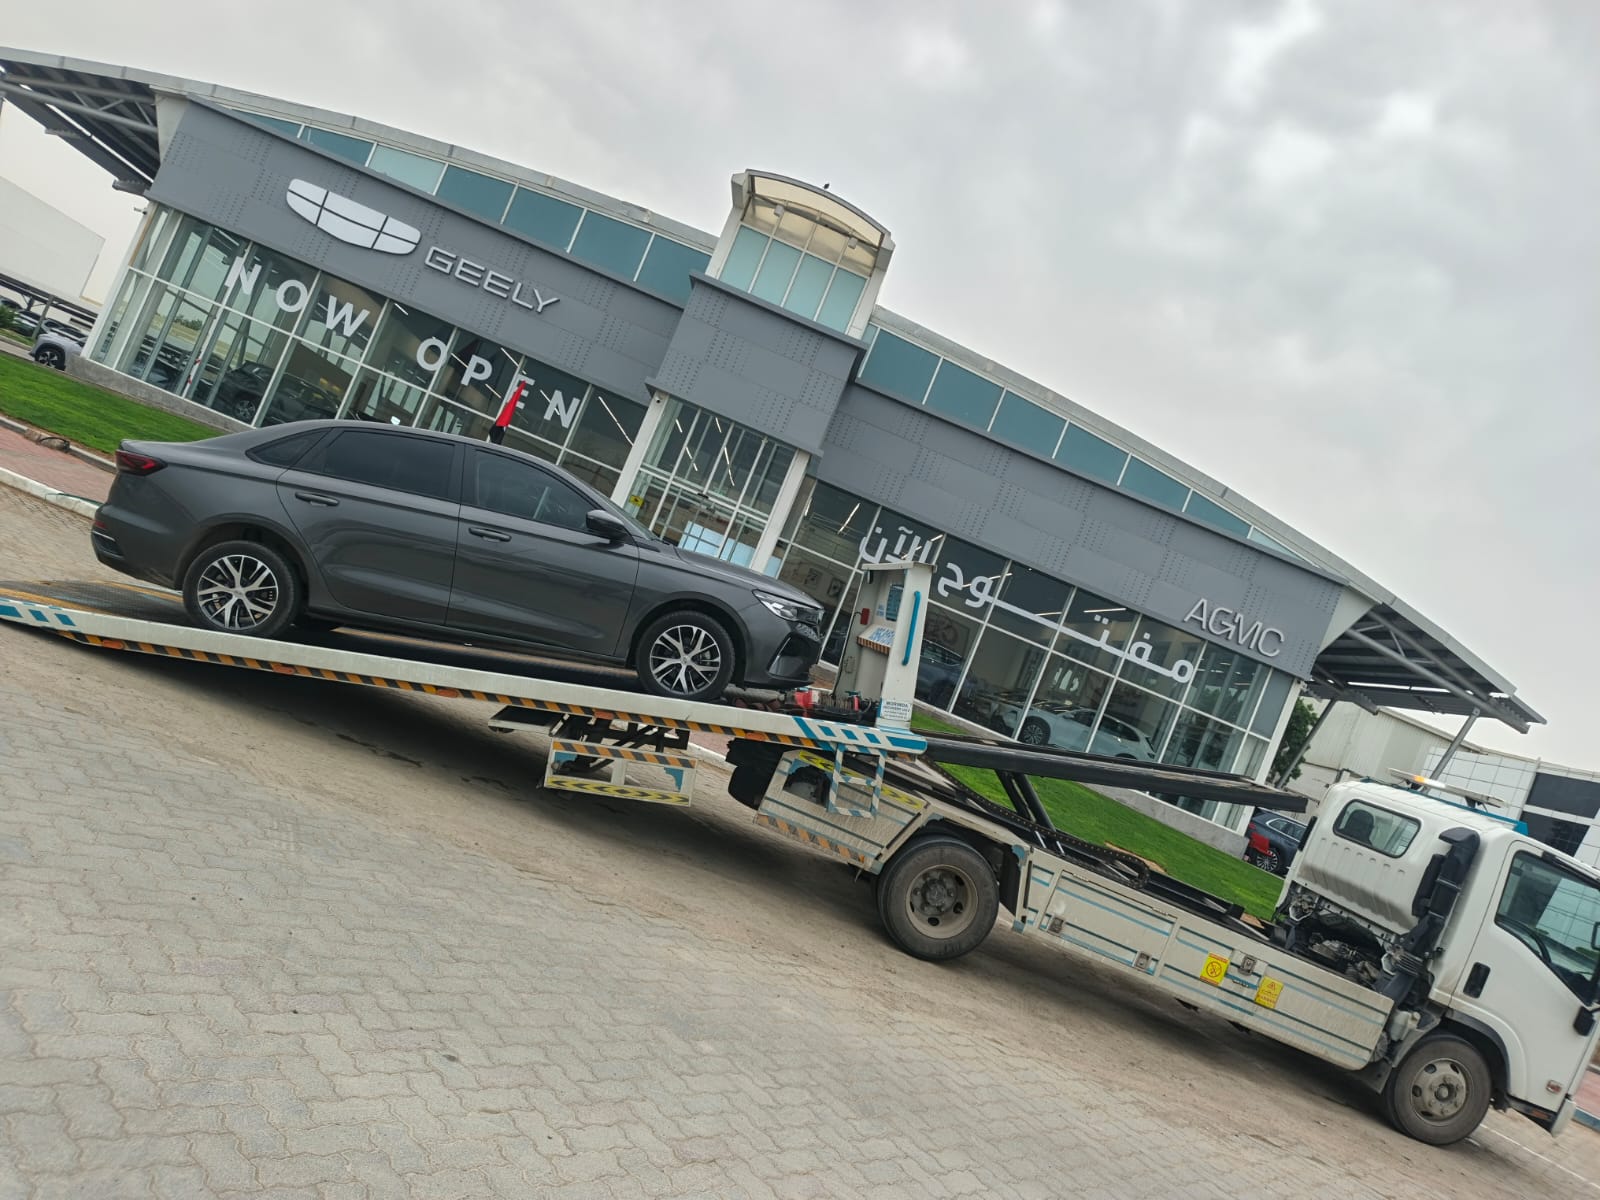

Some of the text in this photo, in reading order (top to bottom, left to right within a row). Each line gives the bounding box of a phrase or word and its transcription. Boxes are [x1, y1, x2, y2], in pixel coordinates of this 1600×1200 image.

[425, 246, 560, 313] GEELY
[225, 256, 580, 429] NOW OPEN
[1183, 598, 1284, 657] AGMC
